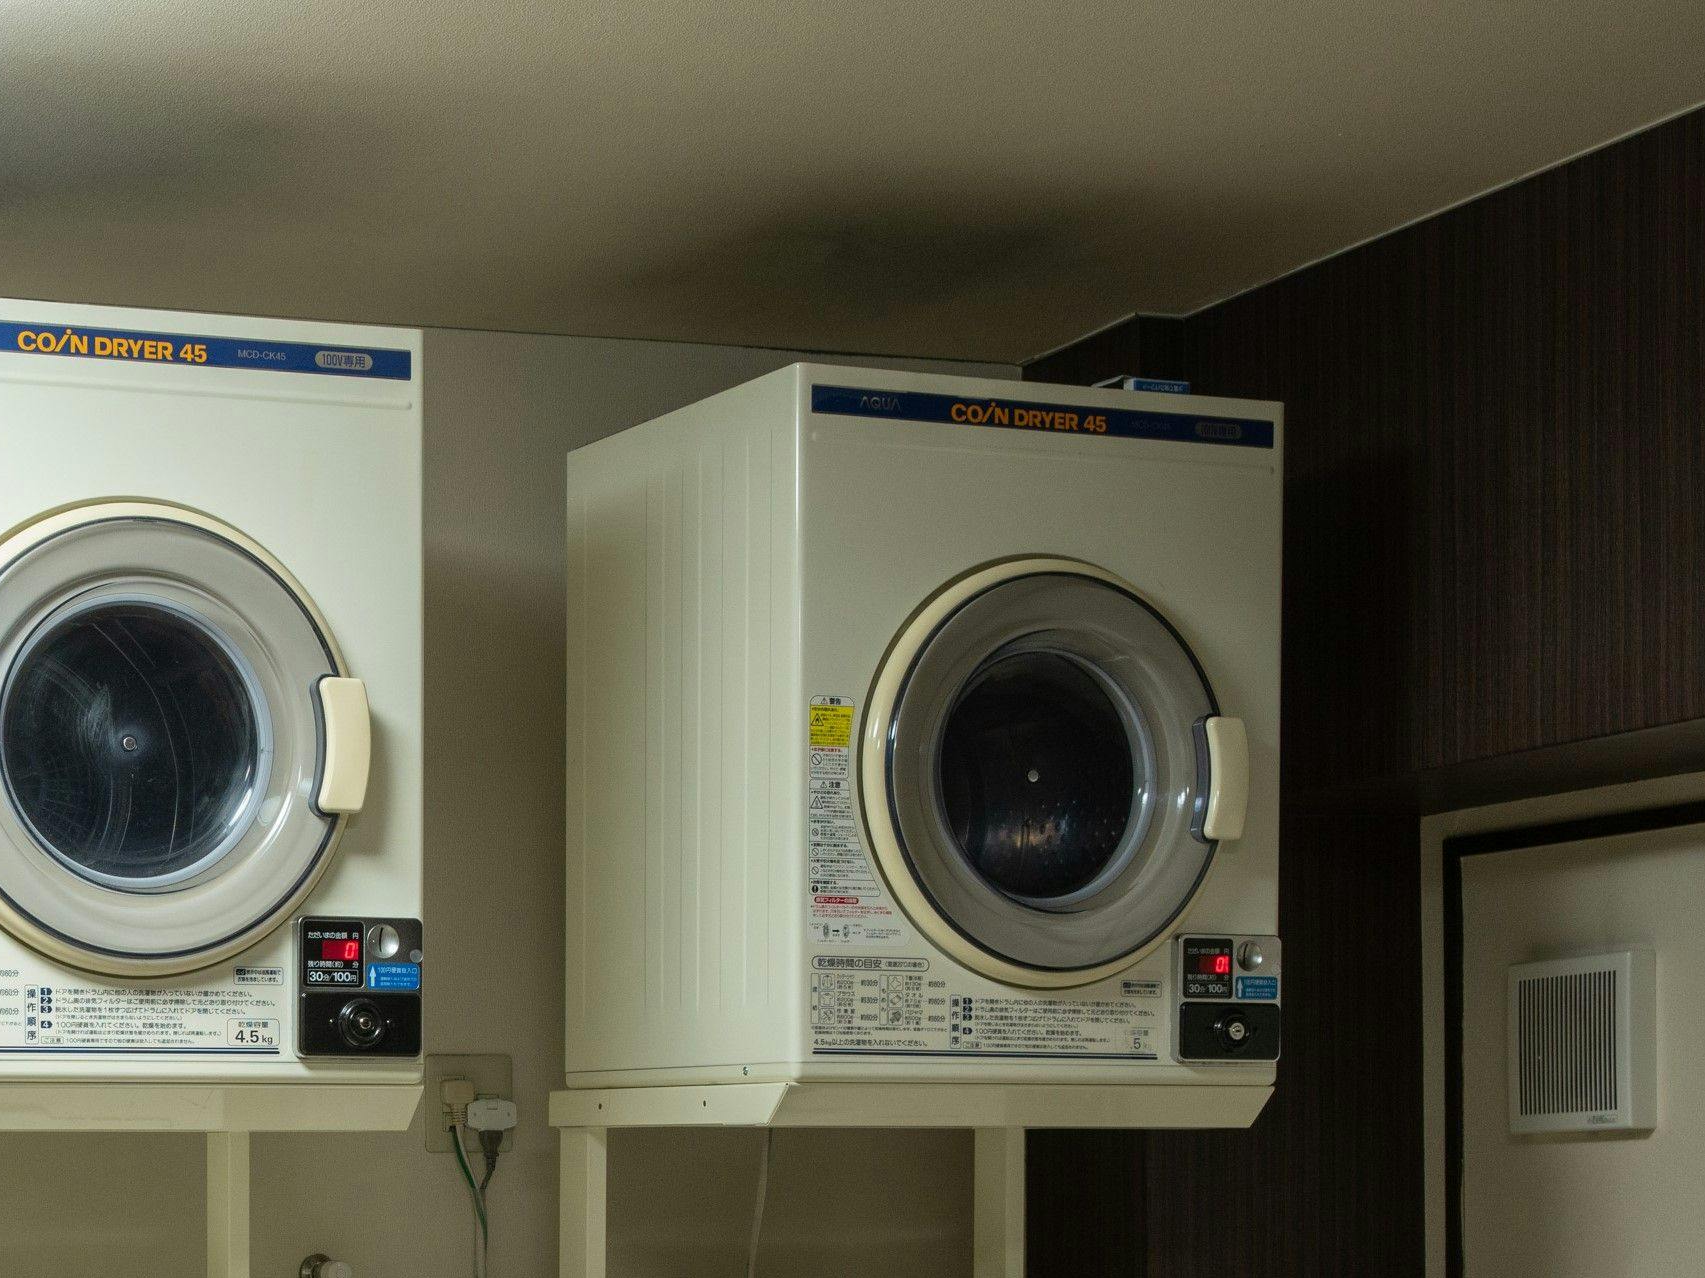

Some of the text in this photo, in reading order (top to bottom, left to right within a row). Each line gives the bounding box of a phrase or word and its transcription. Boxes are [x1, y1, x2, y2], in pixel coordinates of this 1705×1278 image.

[94, 337, 173, 361] DRYER
[179, 343, 208, 364] 45
[237, 349, 287, 362] MCD-CK45
[1014, 409, 1079, 430] DRYER
[1084, 414, 1107, 433] 45
[352, 932, 359, 940] 円
[344, 942, 356, 959] 0
[352, 961, 359, 969] 分
[309, 971, 357, 982] 30分/100円
[235, 1029, 273, 1045] 4.5 kg
